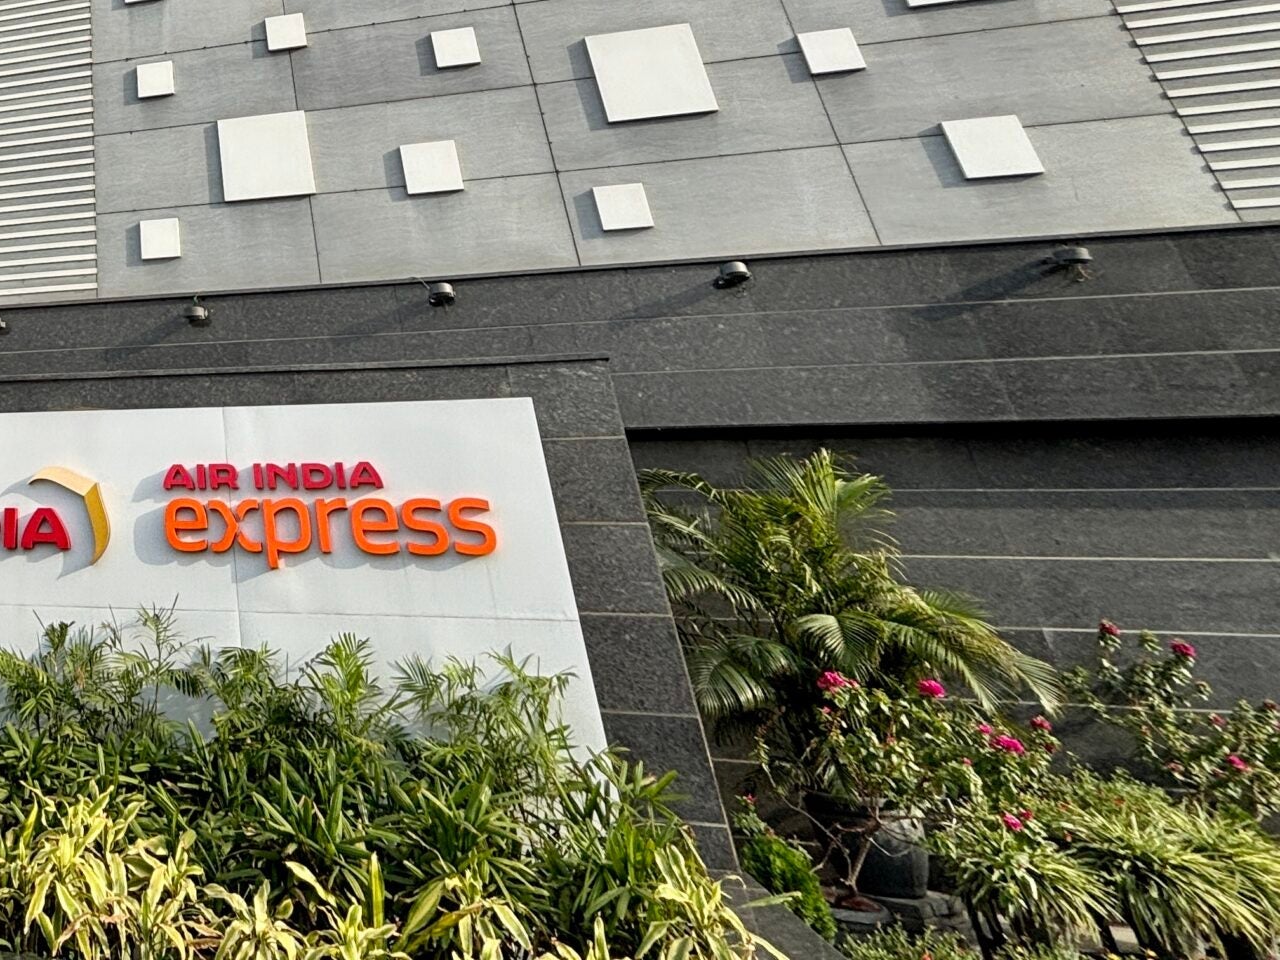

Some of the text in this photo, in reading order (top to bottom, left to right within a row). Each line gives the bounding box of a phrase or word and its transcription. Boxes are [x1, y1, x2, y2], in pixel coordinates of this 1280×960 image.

[164, 461, 384, 492] AIR INDIA
[163, 496, 497, 570] express
